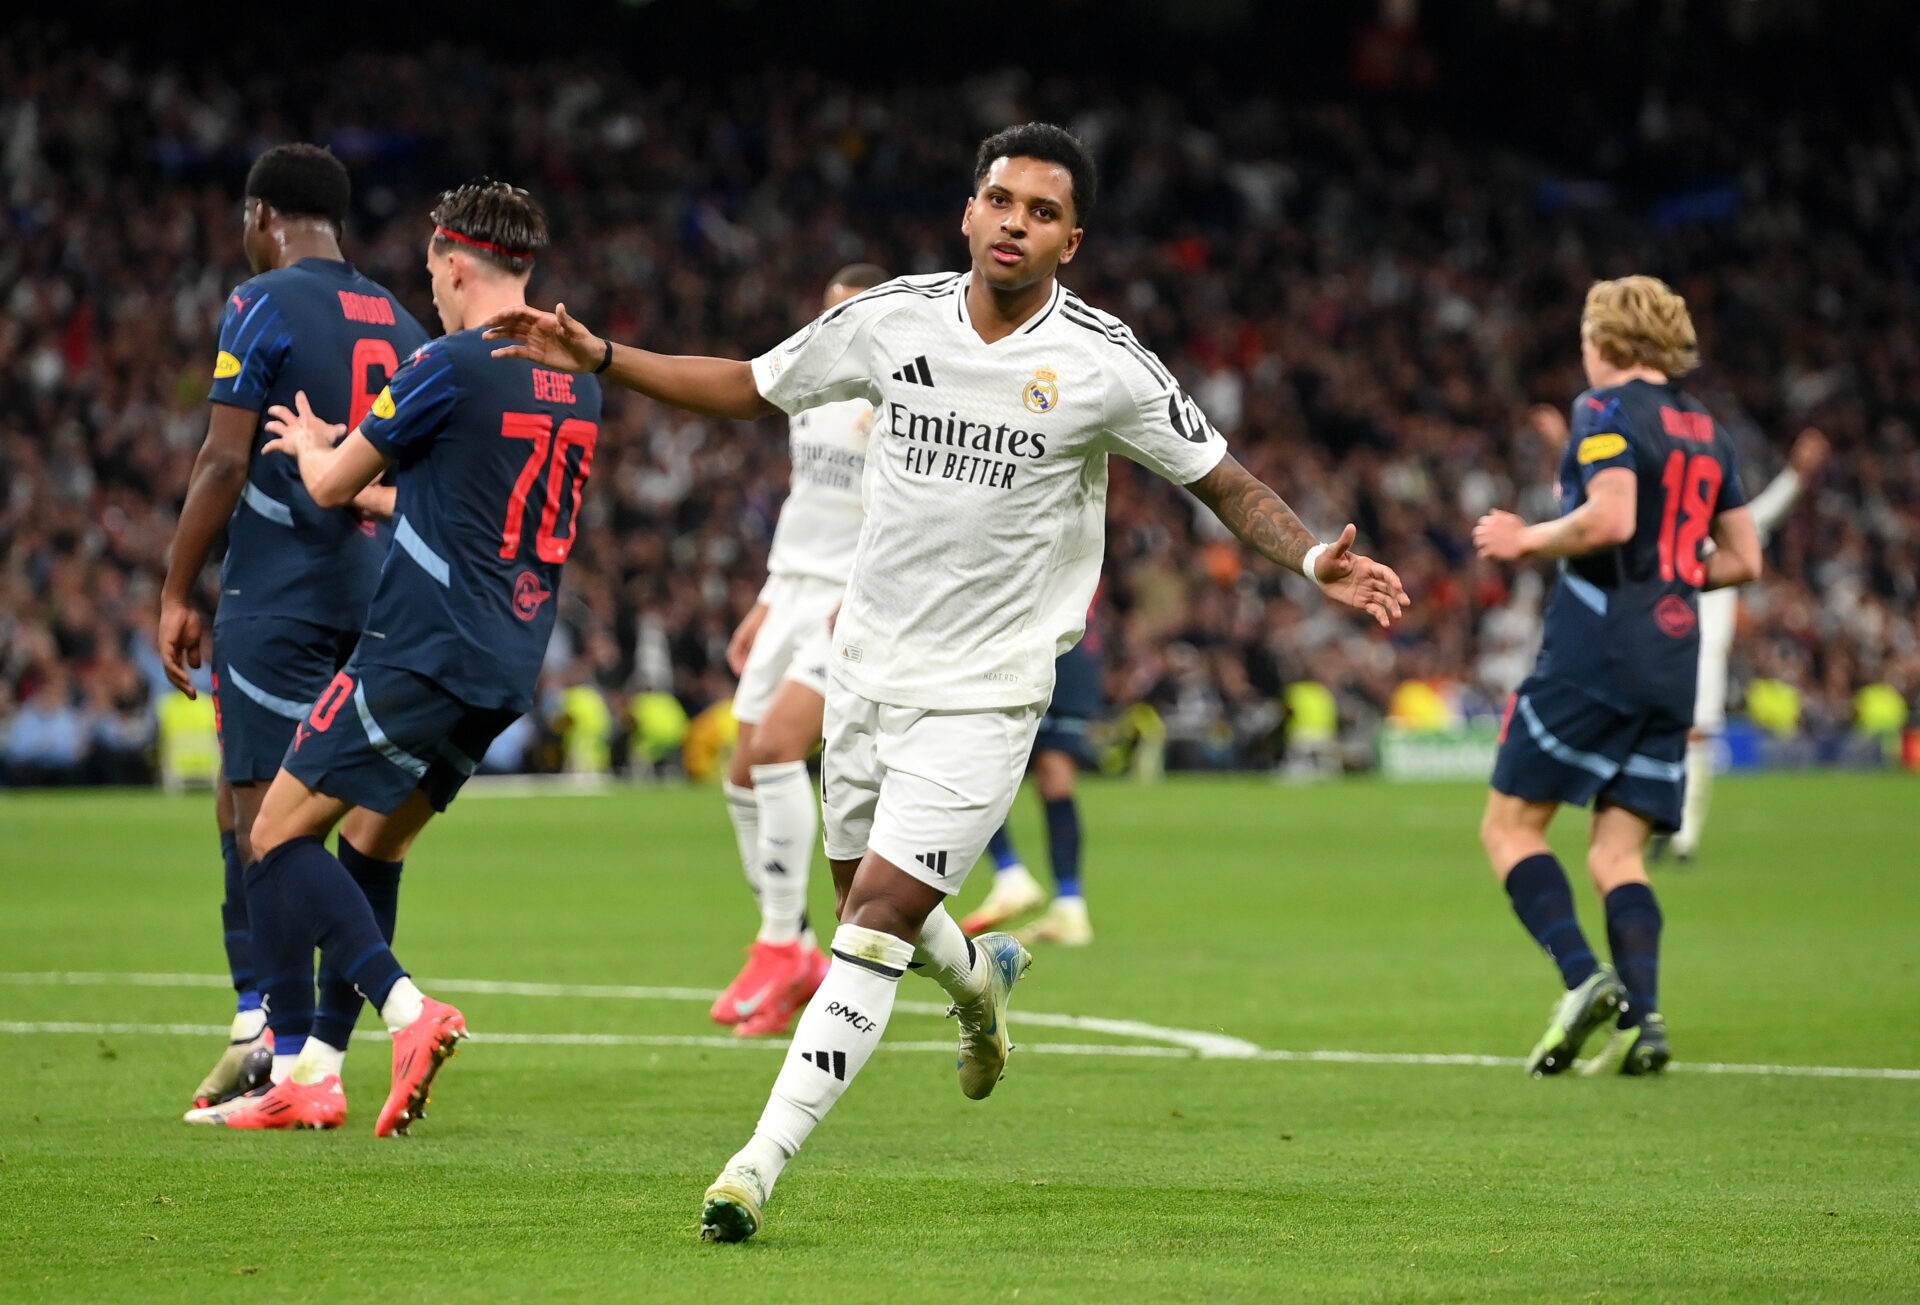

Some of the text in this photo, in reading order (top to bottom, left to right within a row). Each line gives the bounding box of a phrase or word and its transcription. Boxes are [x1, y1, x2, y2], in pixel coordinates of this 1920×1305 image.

[890, 402, 1046, 459] Emirates
[499, 411, 598, 564] 70
[905, 446, 938, 476] FLY
[942, 453, 1017, 490] BETTER
[1658, 449, 1722, 588] 18
[824, 1001, 877, 1033] RMCF
